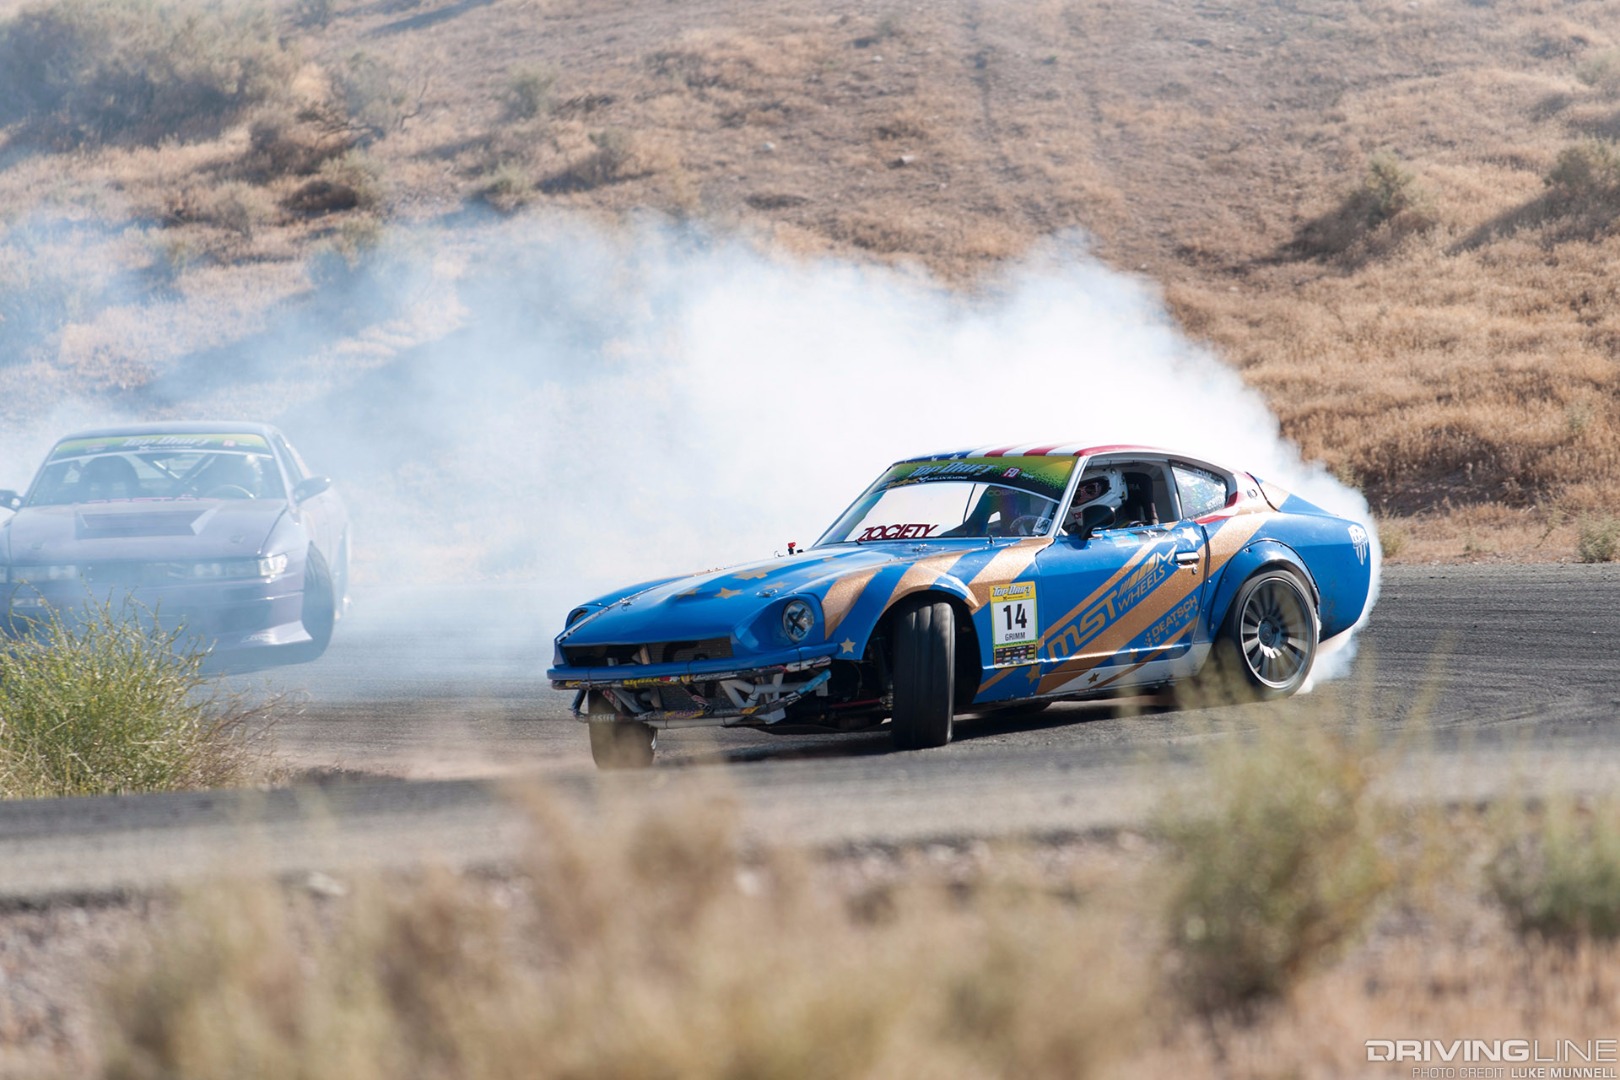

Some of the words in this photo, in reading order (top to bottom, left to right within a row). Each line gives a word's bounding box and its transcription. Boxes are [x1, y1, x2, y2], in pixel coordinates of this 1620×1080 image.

[908, 465, 943, 478] TOP
[993, 586, 1009, 597] TOP
[1008, 584, 1032, 596] DRIFT
[1117, 564, 1166, 612] WHEELS
[1003, 603, 1028, 631] 14
[1047, 590, 1118, 665] MST
[1151, 595, 1198, 638] DEATSCH
[1005, 632, 1026, 642] GRIMM
